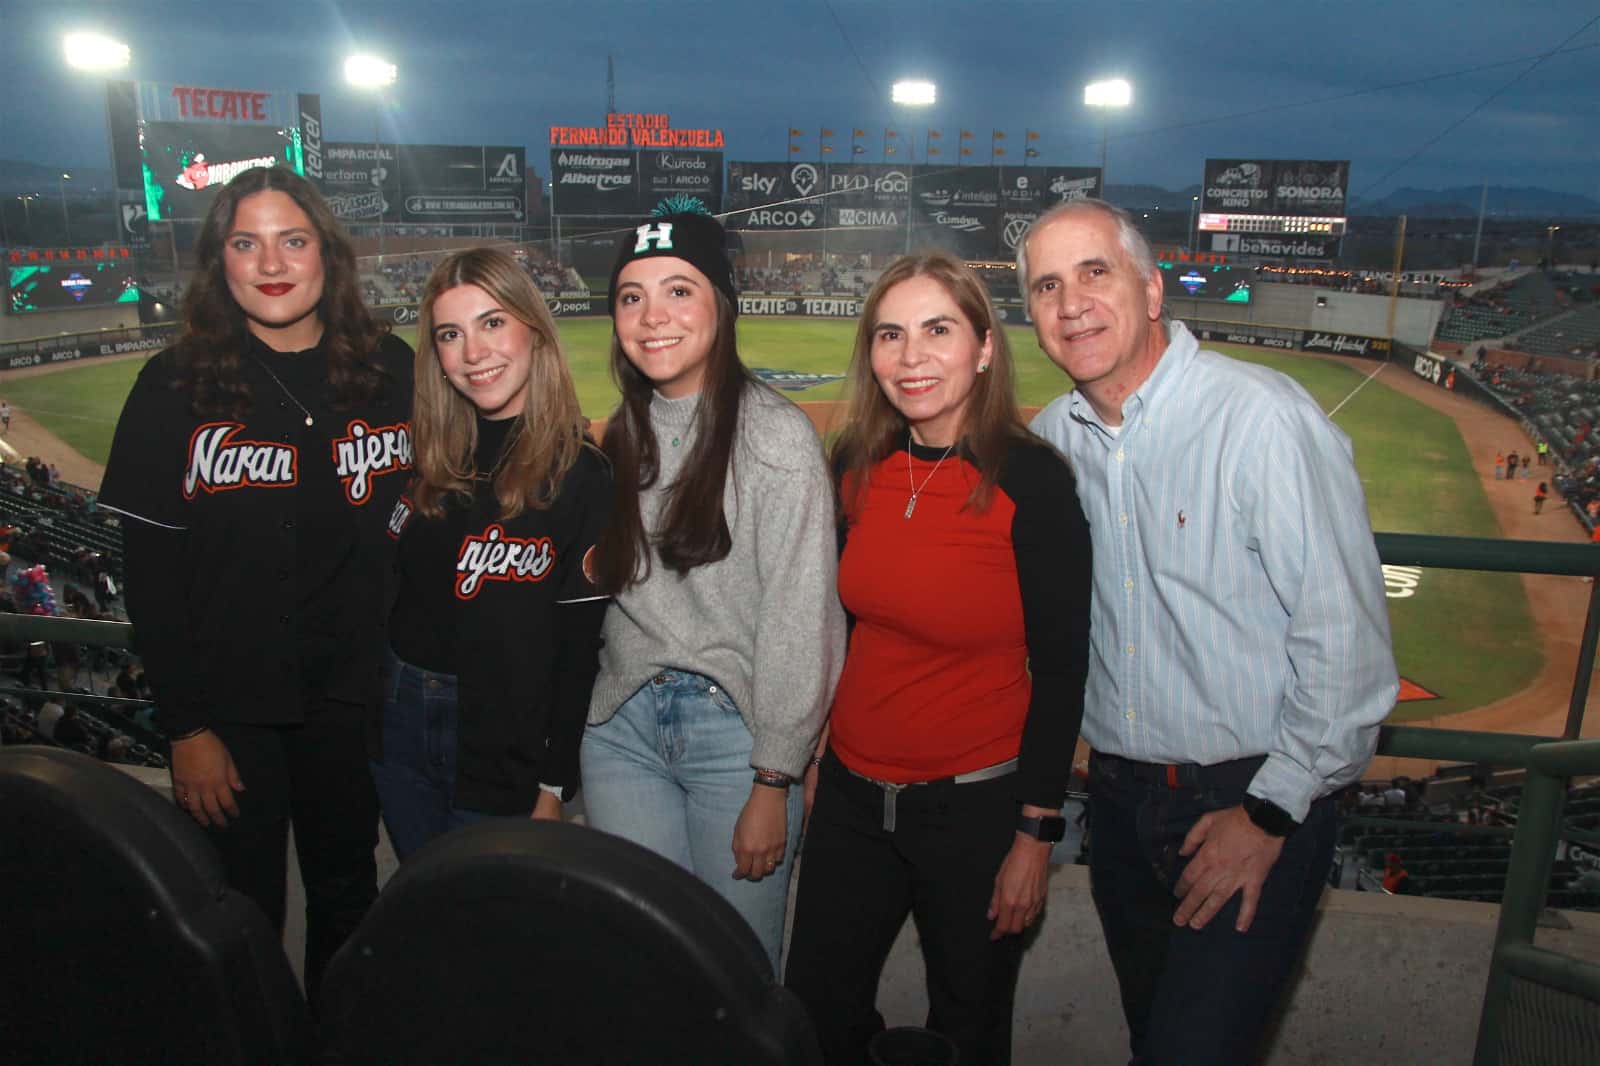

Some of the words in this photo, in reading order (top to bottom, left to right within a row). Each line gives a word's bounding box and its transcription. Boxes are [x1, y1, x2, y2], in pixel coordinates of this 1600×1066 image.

[172, 87, 272, 120] TECATE
[607, 113, 669, 129] ESTADIO
[303, 112, 322, 178] telcel
[550, 126, 627, 145] FERNANDO
[630, 129, 725, 148] VALENZUELA
[327, 149, 393, 160] IMPARCIAL
[661, 153, 706, 169] Kuroda
[560, 172, 632, 190] Albatros
[675, 175, 701, 185] ARCO
[741, 172, 776, 195] sky
[1206, 187, 1268, 199] CONCRETOS
[1278, 186, 1344, 199] SONORA
[747, 211, 797, 225] ARCO
[855, 211, 898, 225] CIMA
[634, 222, 673, 254] H
[1240, 239, 1325, 257] benavides
[562, 301, 590, 312] pepsi
[737, 298, 785, 314] TECATE
[803, 299, 856, 315] TECATE
[185, 423, 297, 497] Naran
[334, 421, 412, 502] njero
[457, 526, 552, 596] njeros
